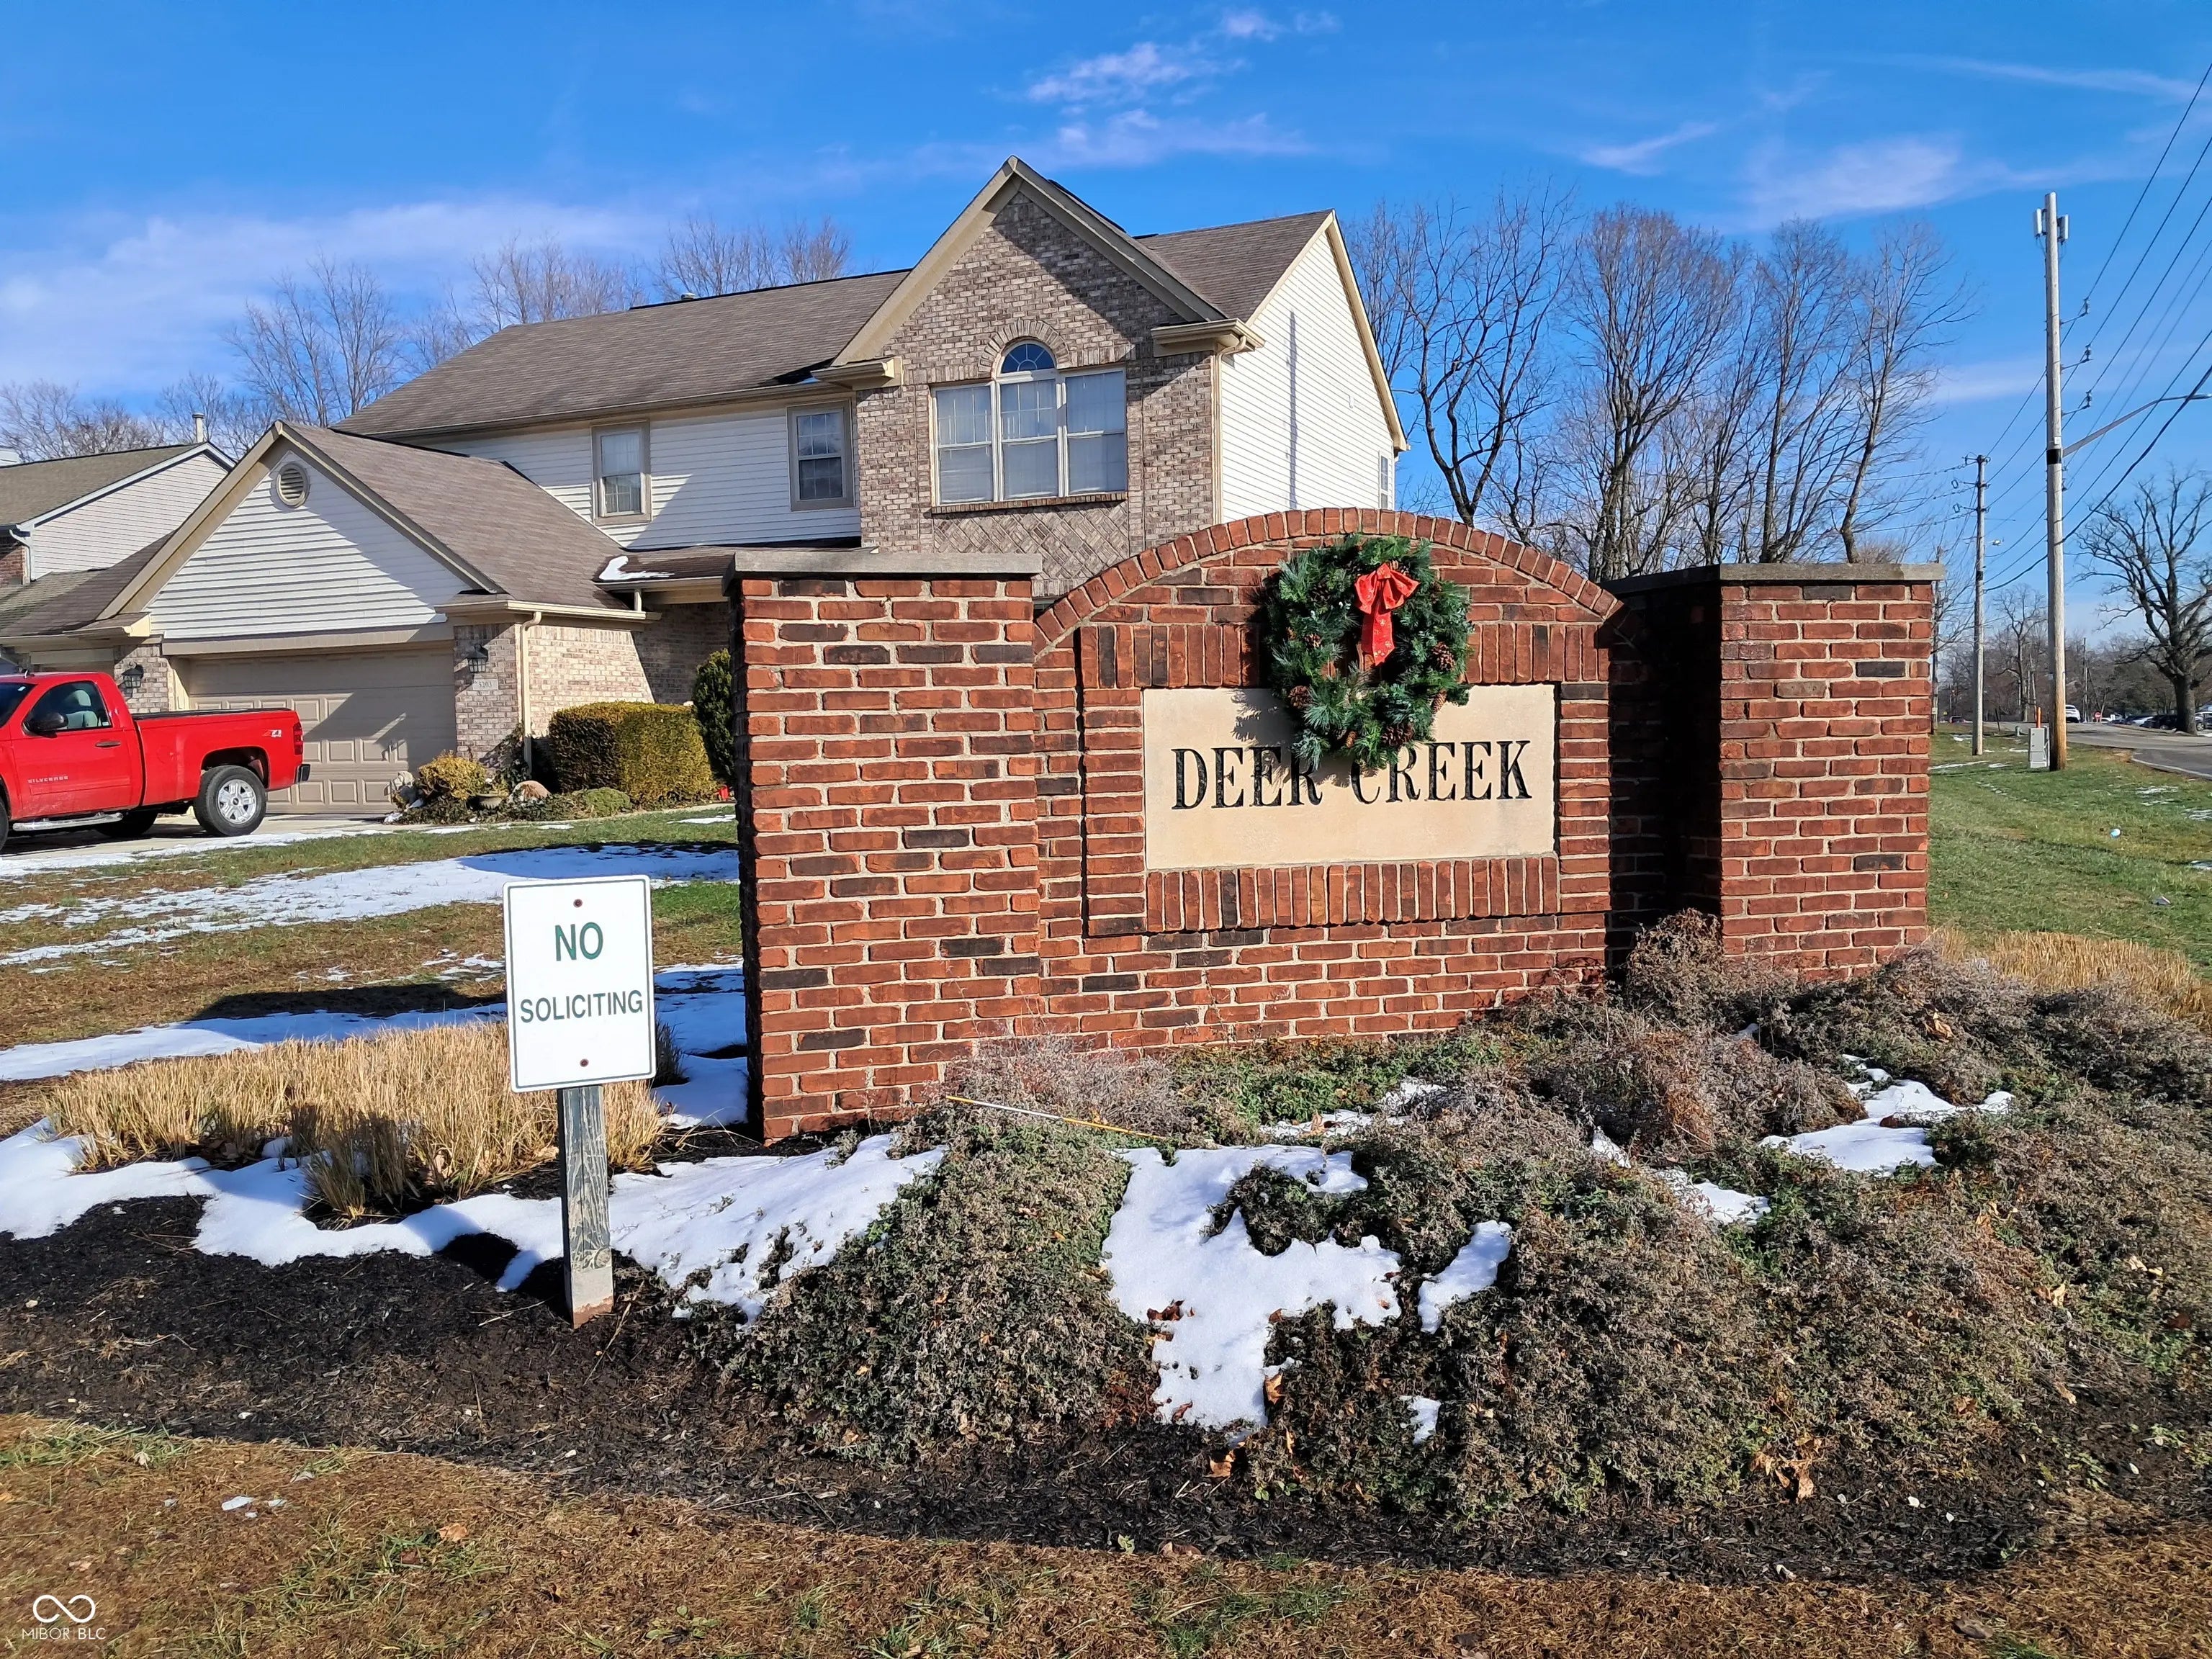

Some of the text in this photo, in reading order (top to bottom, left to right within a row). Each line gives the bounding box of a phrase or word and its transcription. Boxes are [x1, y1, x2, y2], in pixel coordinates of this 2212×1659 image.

[1171, 739, 1533, 810] DEER CREEK
[554, 922, 603, 961] NO
[520, 989, 643, 1023] SOLICITING
